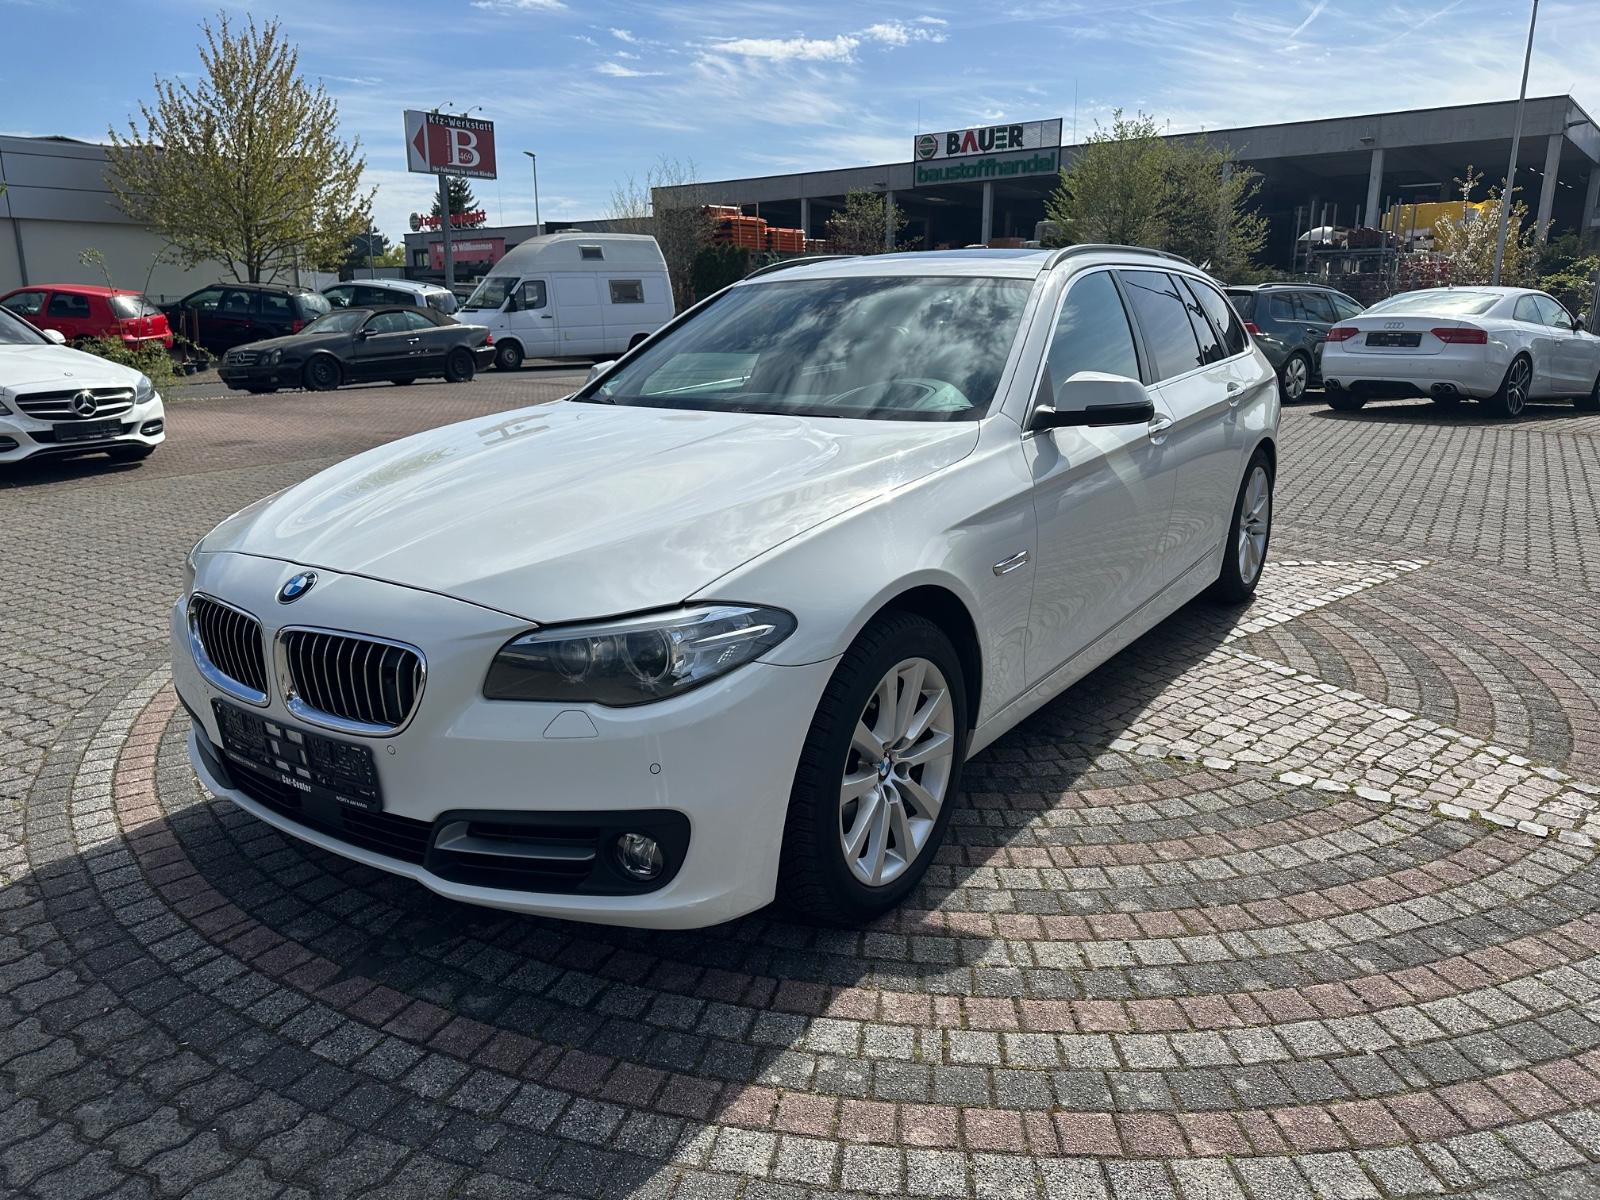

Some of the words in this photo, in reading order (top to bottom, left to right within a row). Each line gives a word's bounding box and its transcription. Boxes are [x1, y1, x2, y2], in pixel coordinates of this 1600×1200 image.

[428, 114, 492, 131] Kfz-Werkstatt
[445, 127, 480, 167] B
[946, 125, 1024, 154] BAUER
[917, 151, 1056, 183] baustoffhandel
[281, 774, 311, 793] Car-Center
